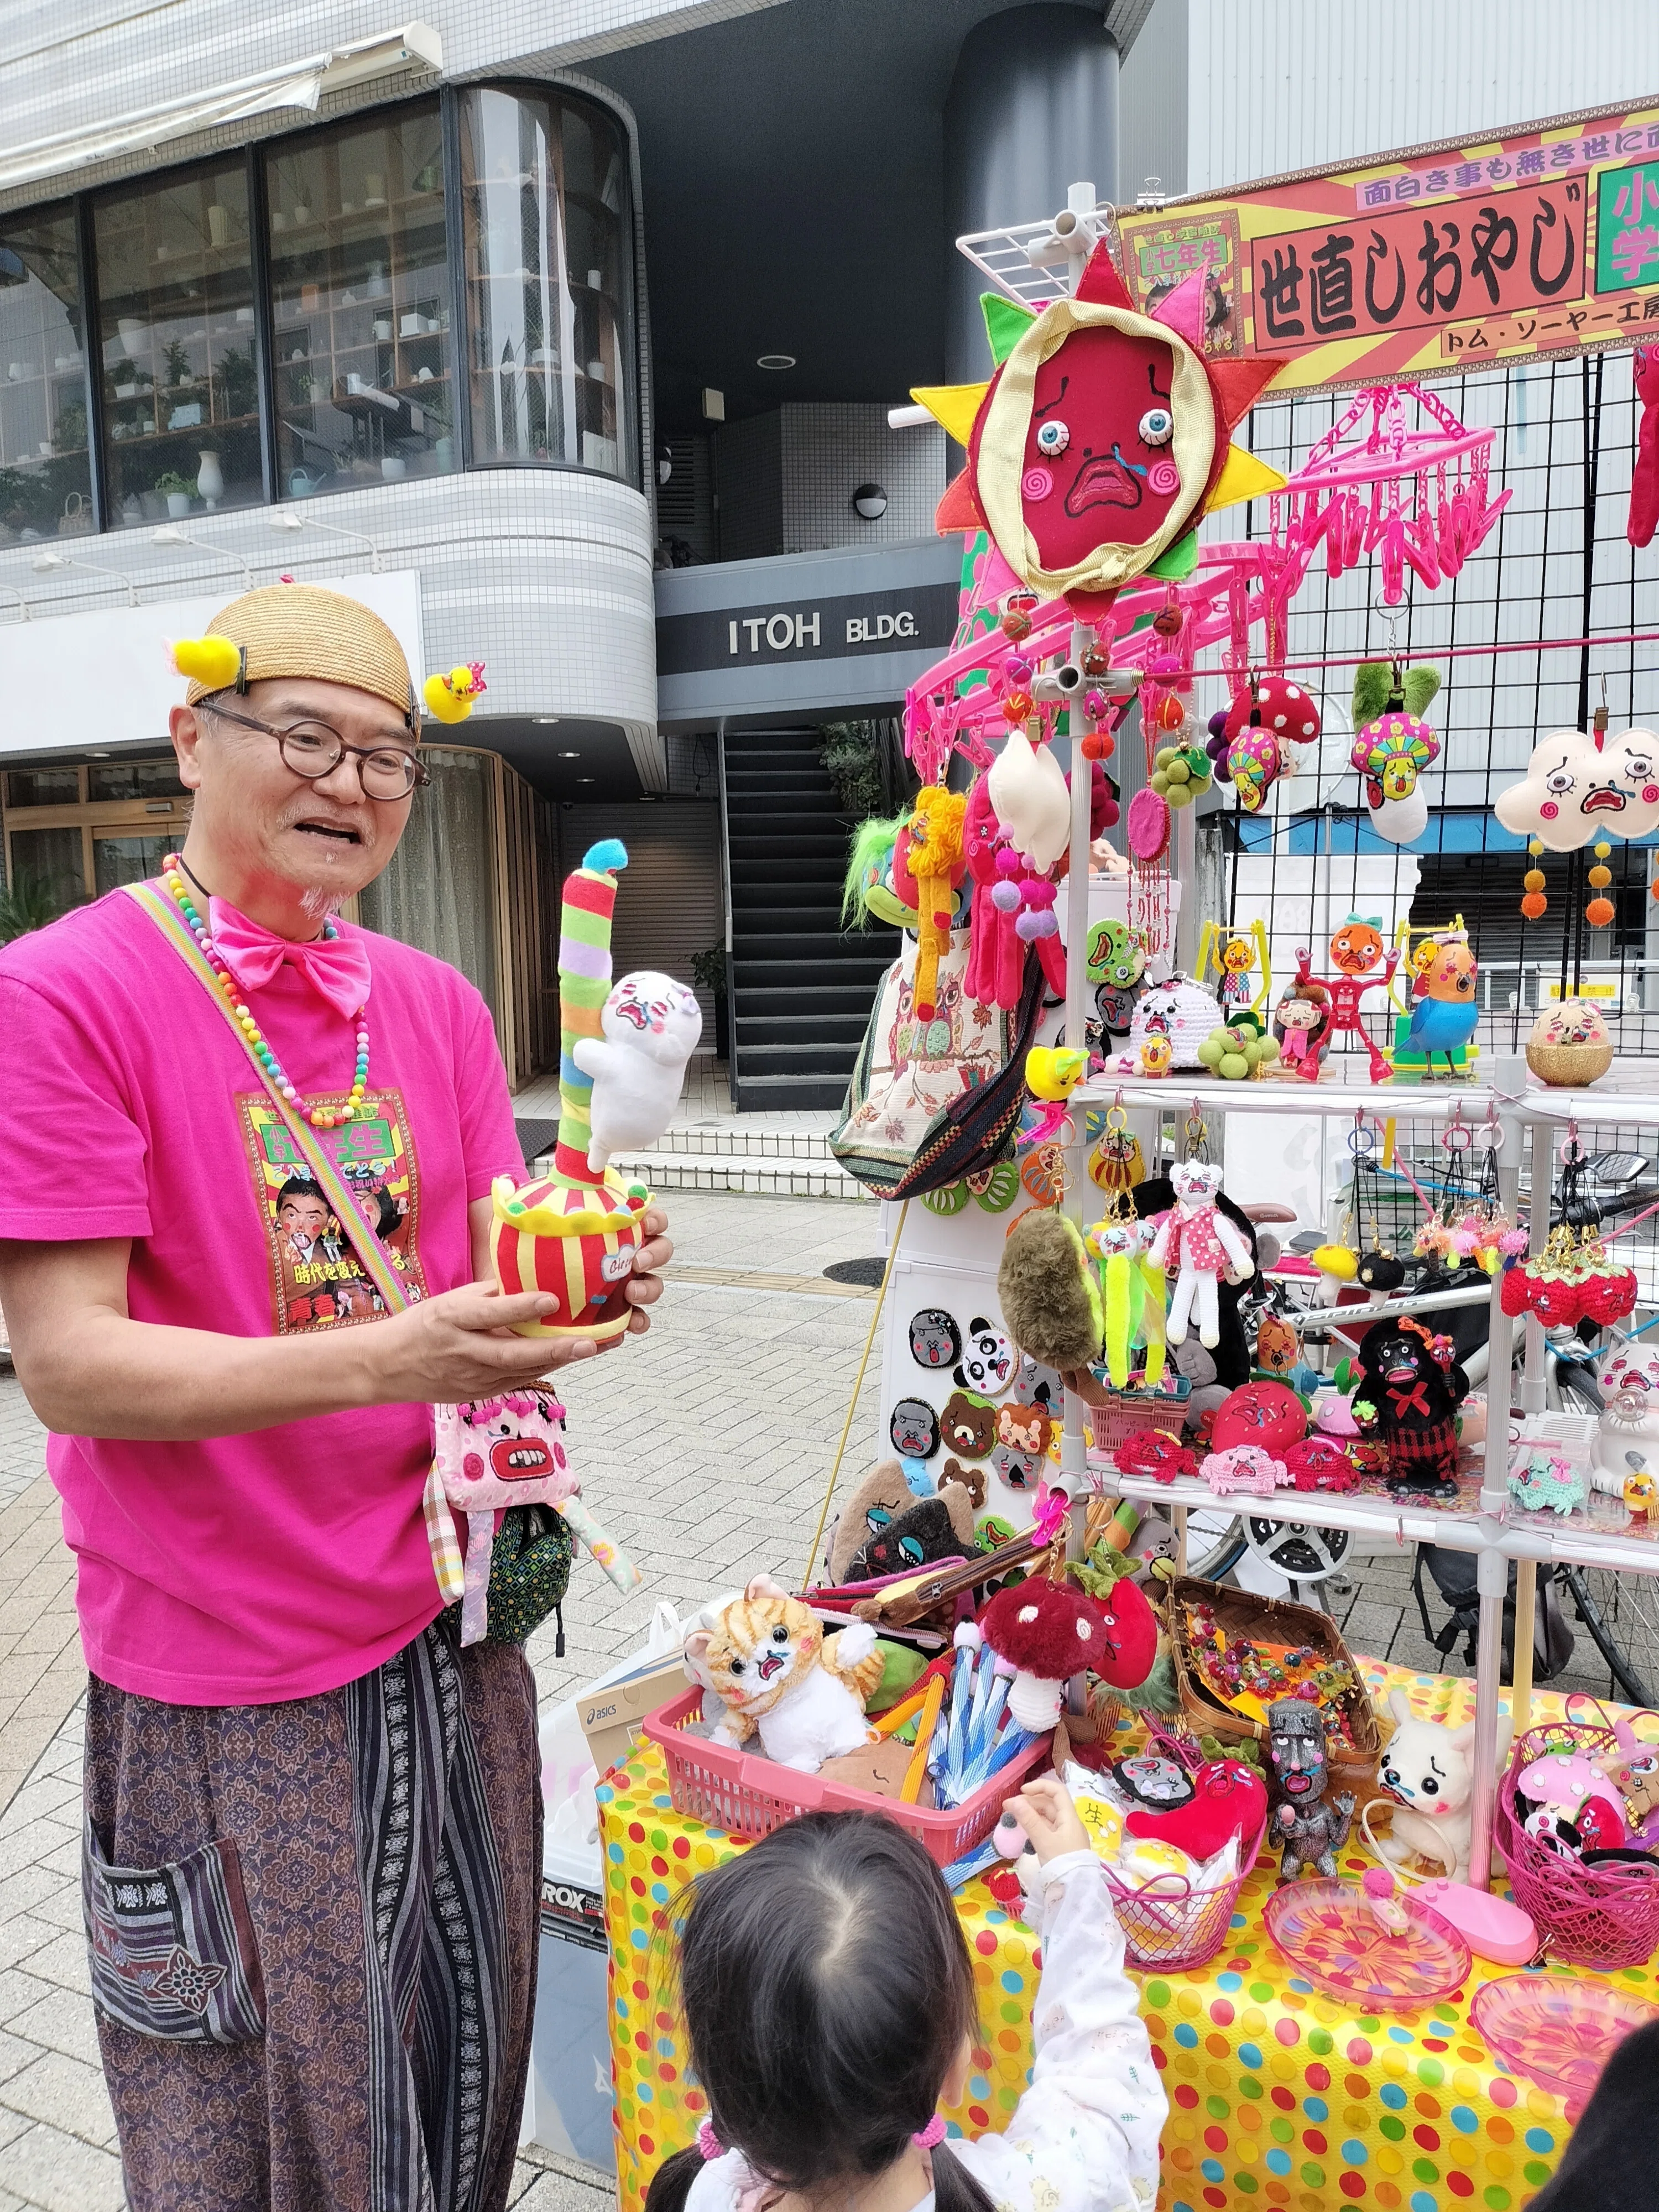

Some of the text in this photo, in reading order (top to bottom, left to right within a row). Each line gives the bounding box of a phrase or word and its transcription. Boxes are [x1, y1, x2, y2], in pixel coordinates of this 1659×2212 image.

[1260, 182, 1580, 336] 世直しおやじ
[729, 612, 919, 654] ITOH BLDG.
[596, 1704, 617, 1719] asics
